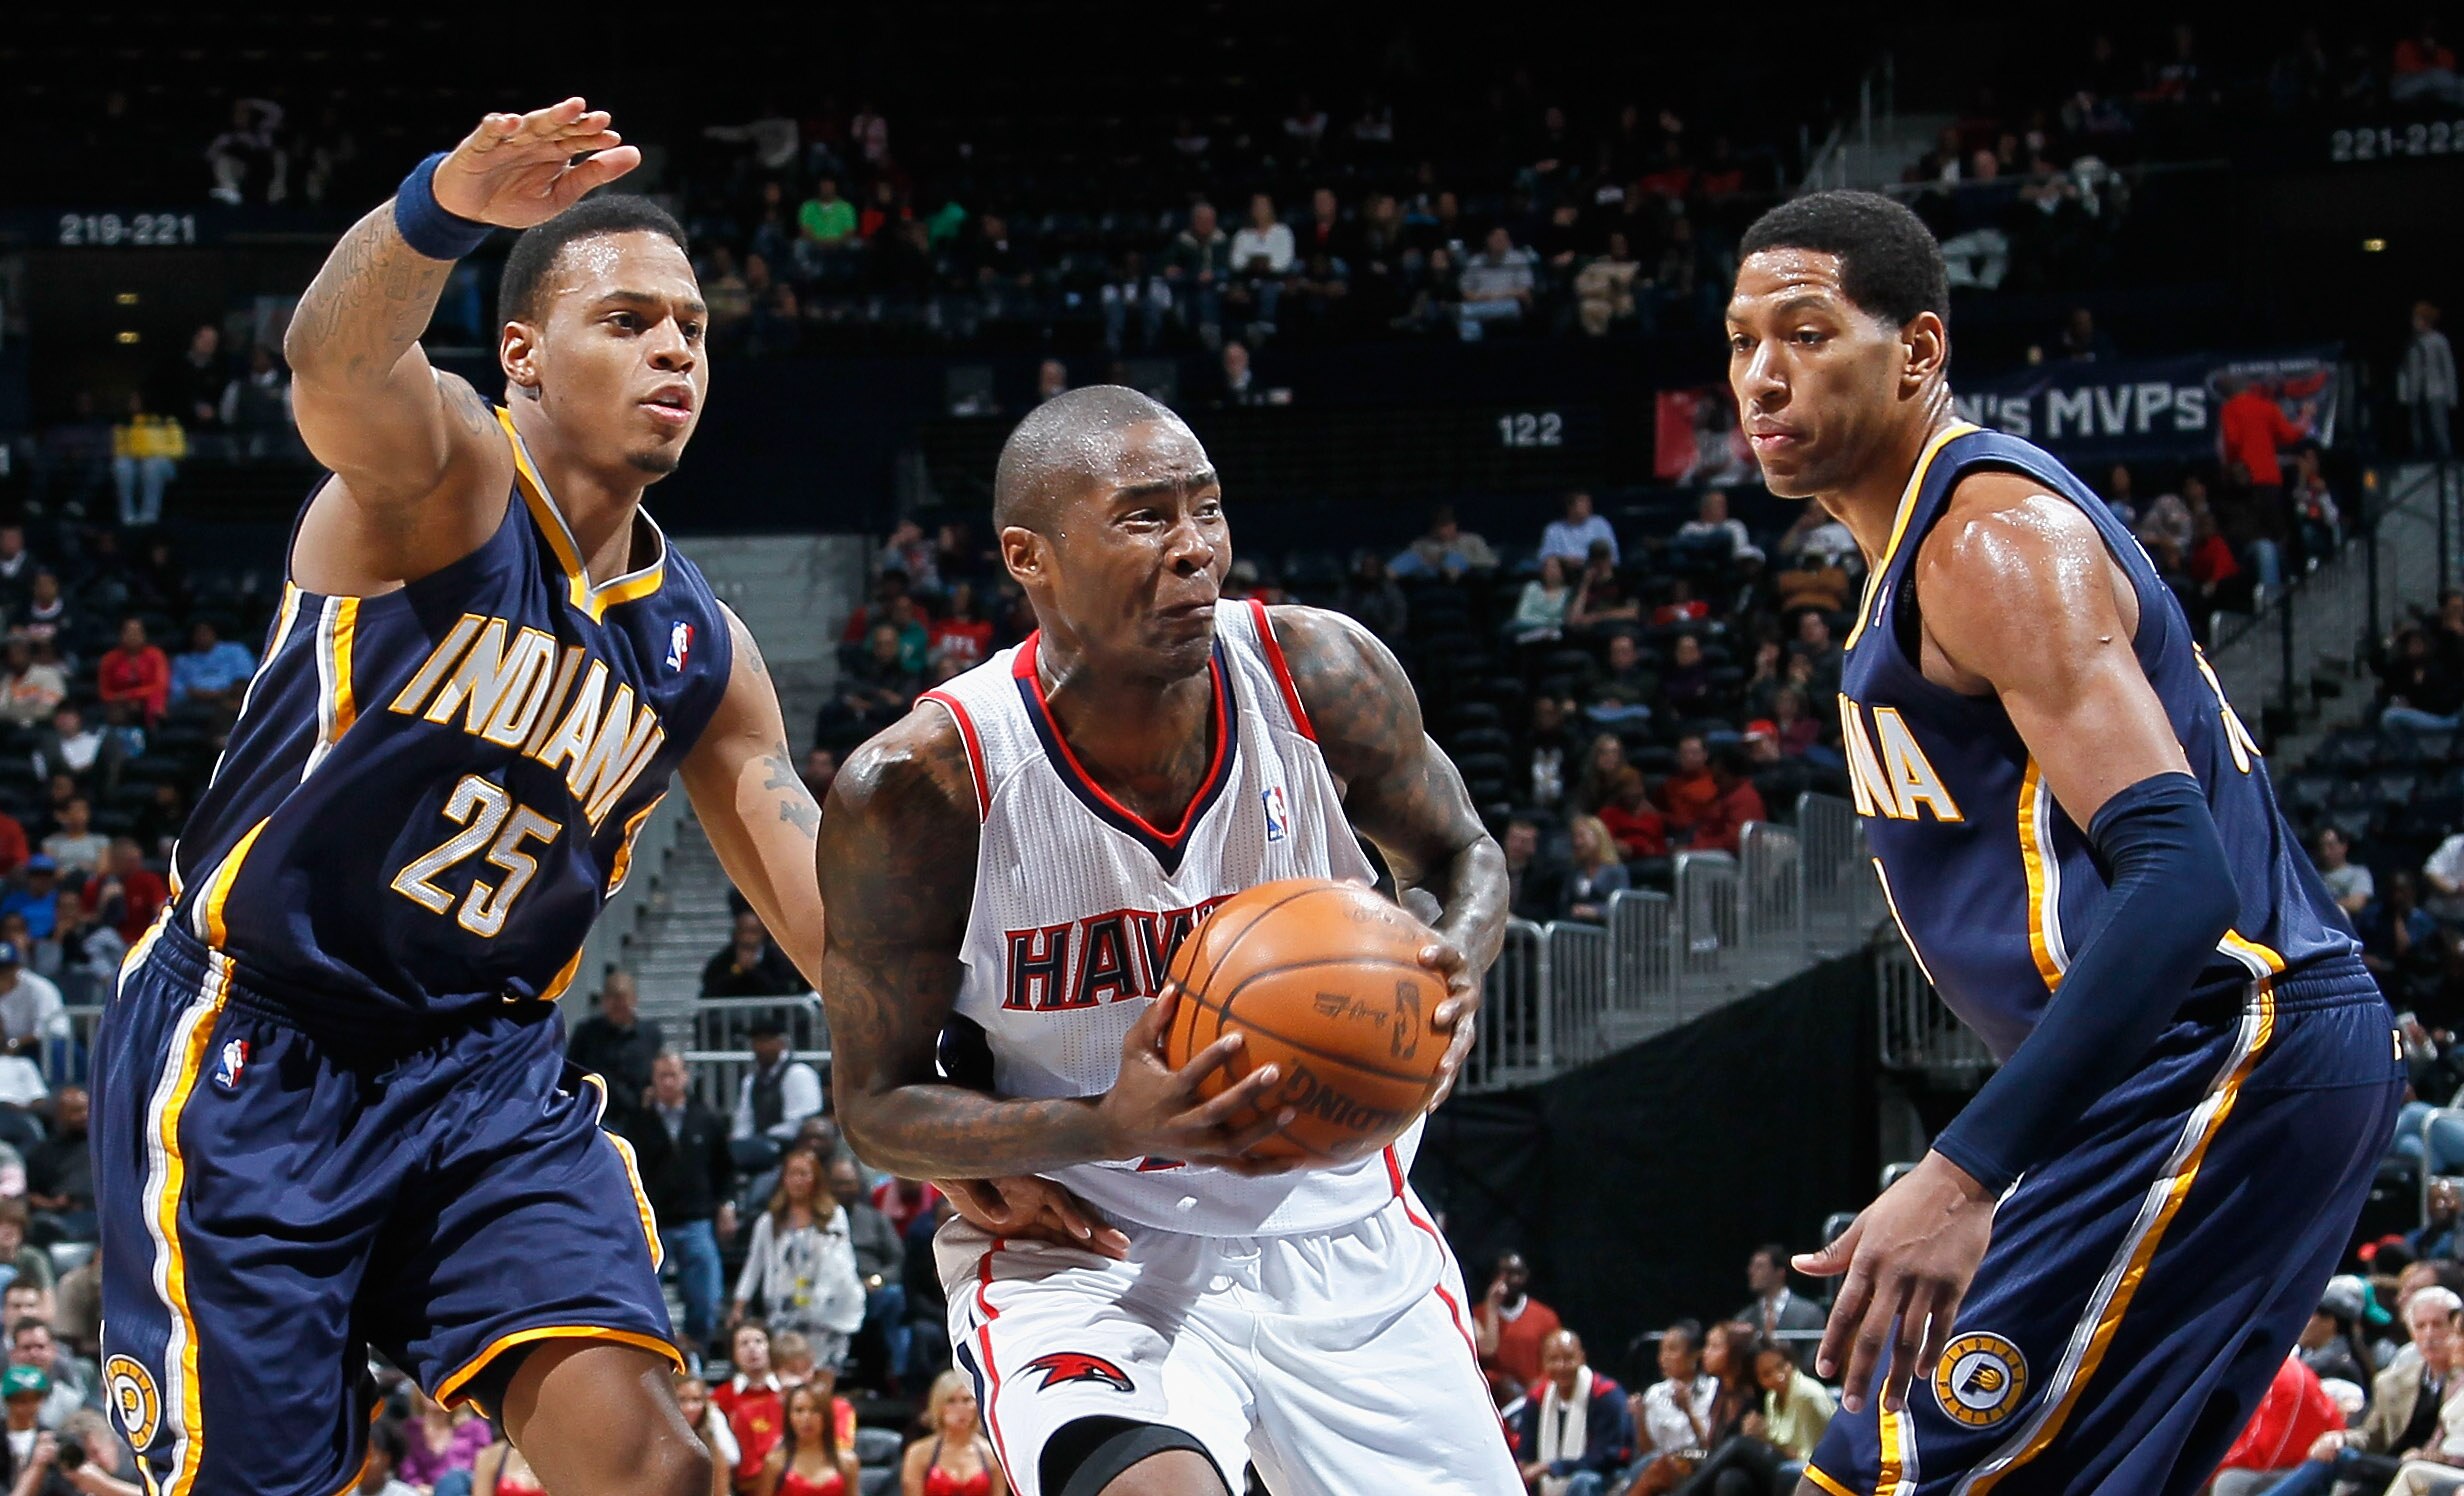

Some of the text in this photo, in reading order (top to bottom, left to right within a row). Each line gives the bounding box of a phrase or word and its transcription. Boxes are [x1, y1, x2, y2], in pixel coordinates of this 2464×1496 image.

[59, 213, 196, 245] 219-221
[1499, 412, 1562, 446] 122
[388, 612, 665, 837] INDIAN
[390, 774, 562, 938] 25
[1001, 892, 1237, 1012] HAW
